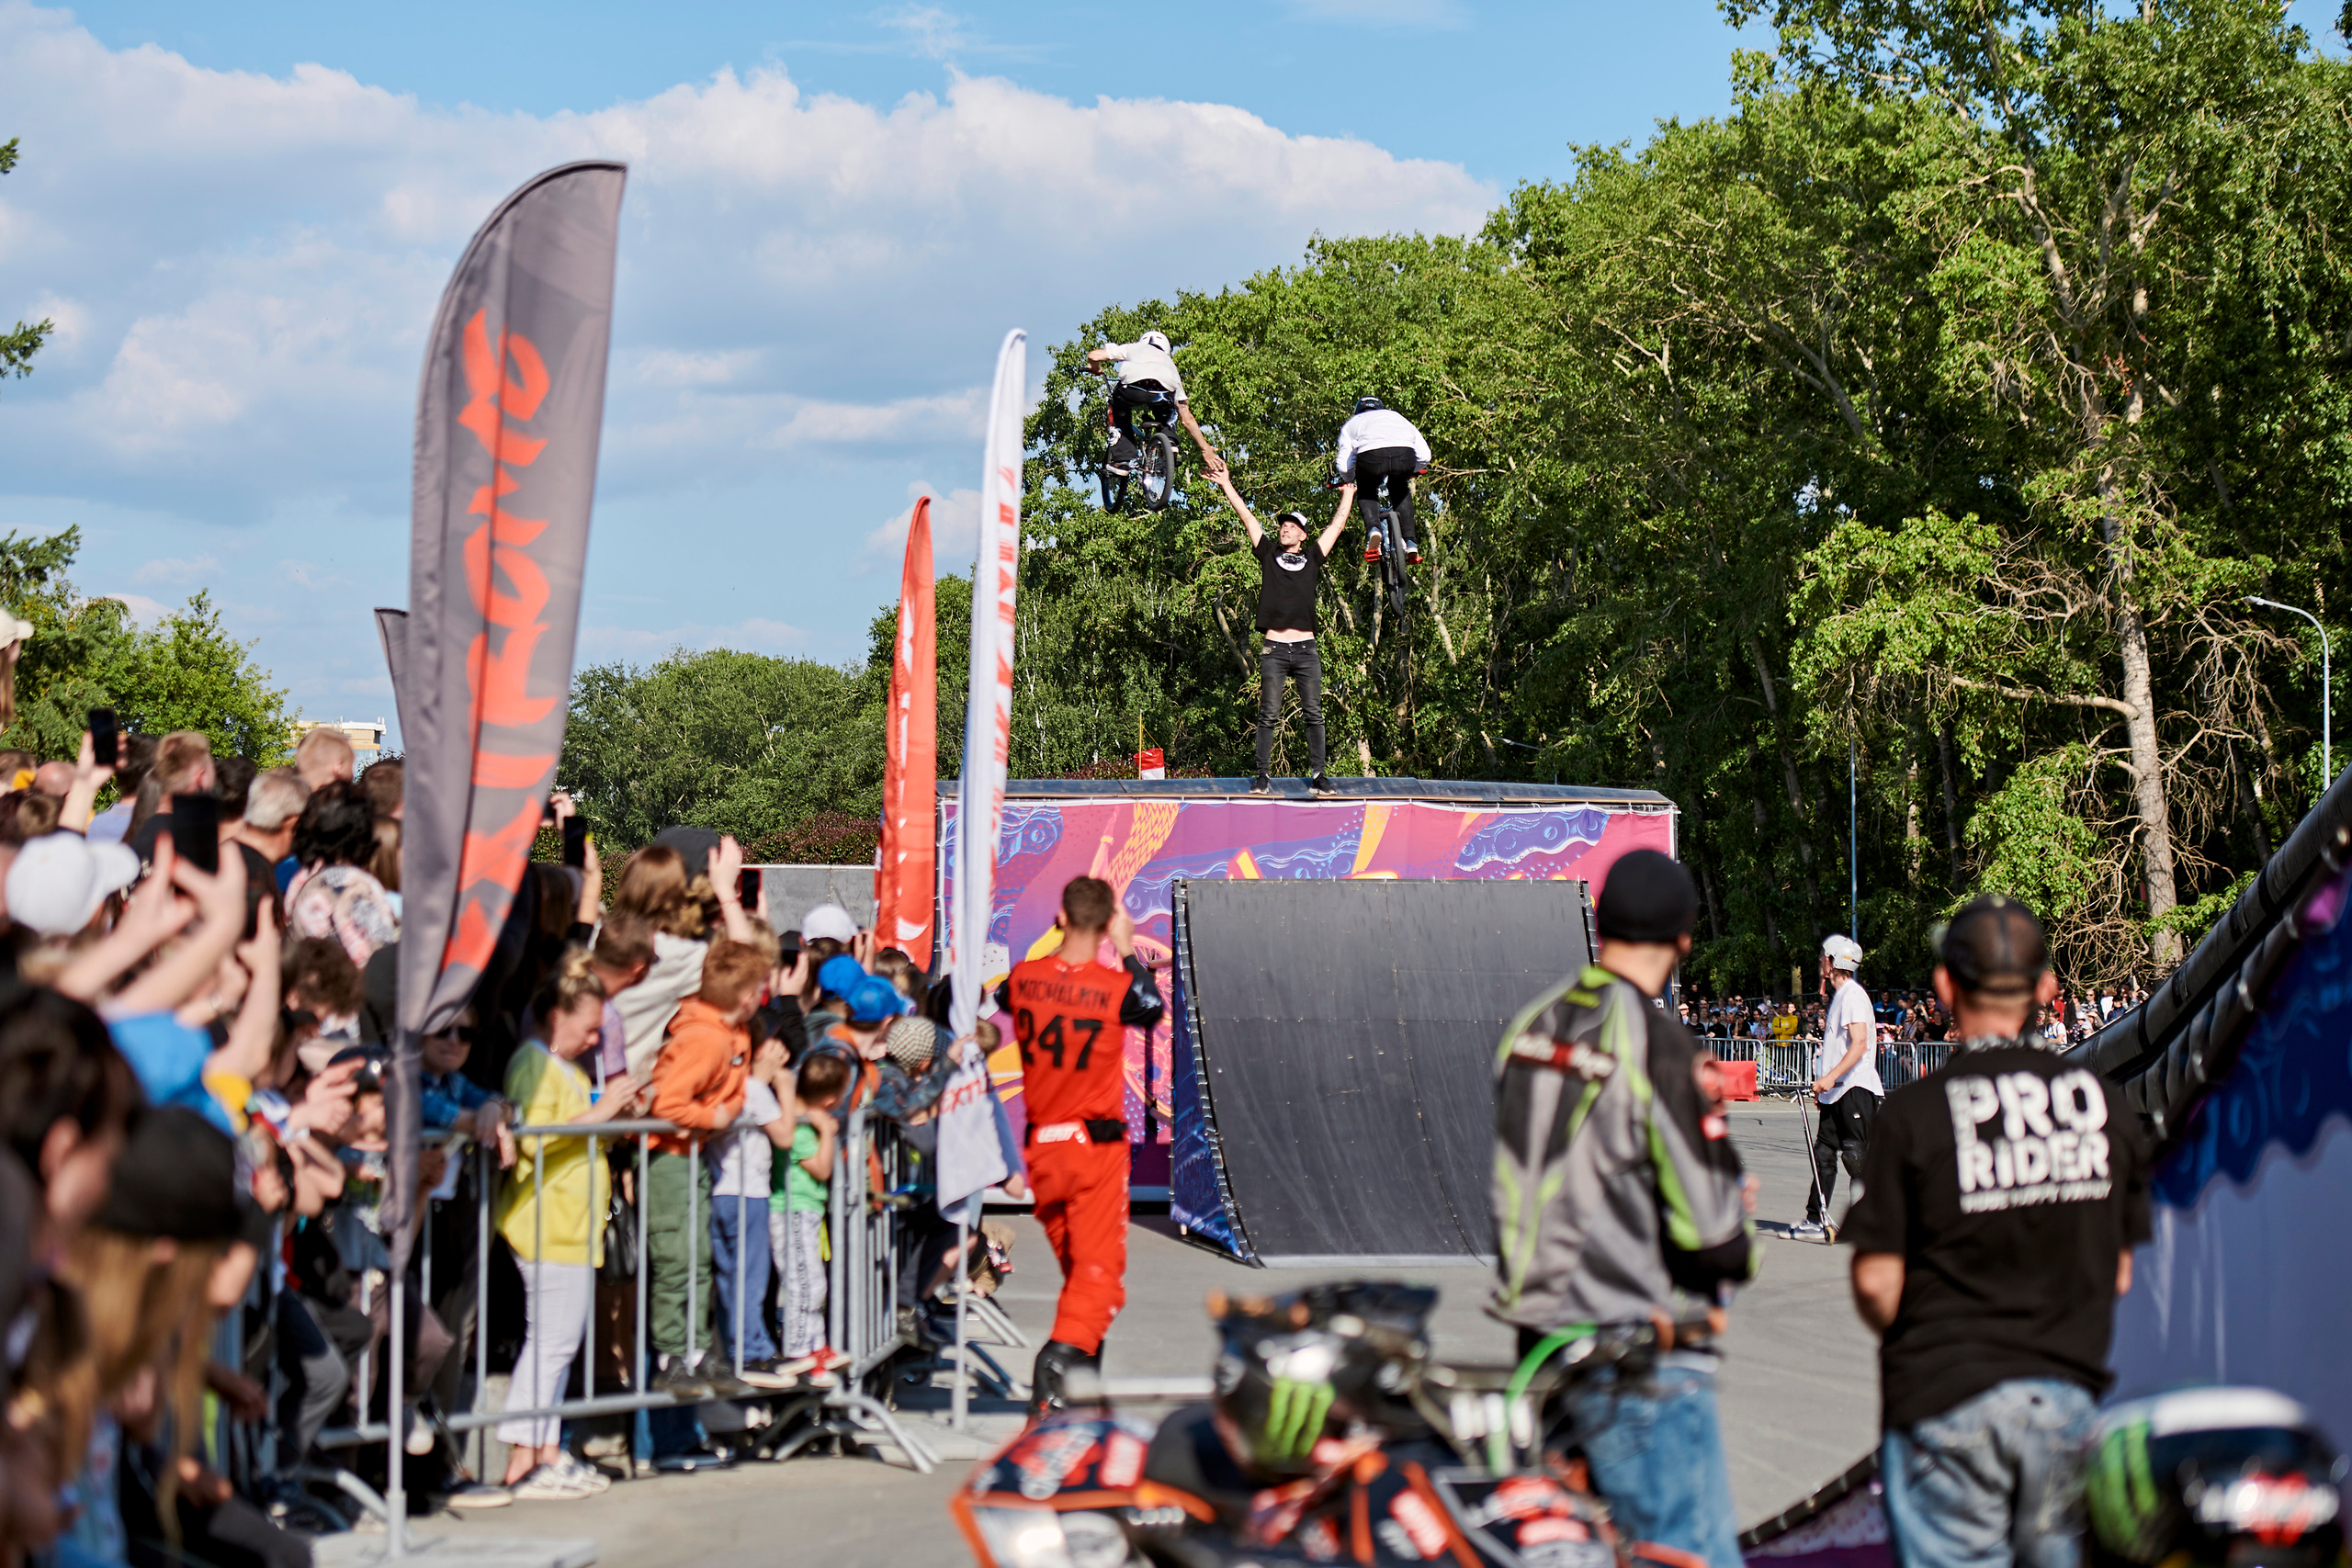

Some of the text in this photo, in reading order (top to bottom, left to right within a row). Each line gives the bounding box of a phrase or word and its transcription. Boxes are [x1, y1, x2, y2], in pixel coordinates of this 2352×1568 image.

[1017, 1008, 1104, 1072] 247
[1944, 1067, 2109, 1145] PRO
[1956, 1129, 2110, 1193] RIDER
